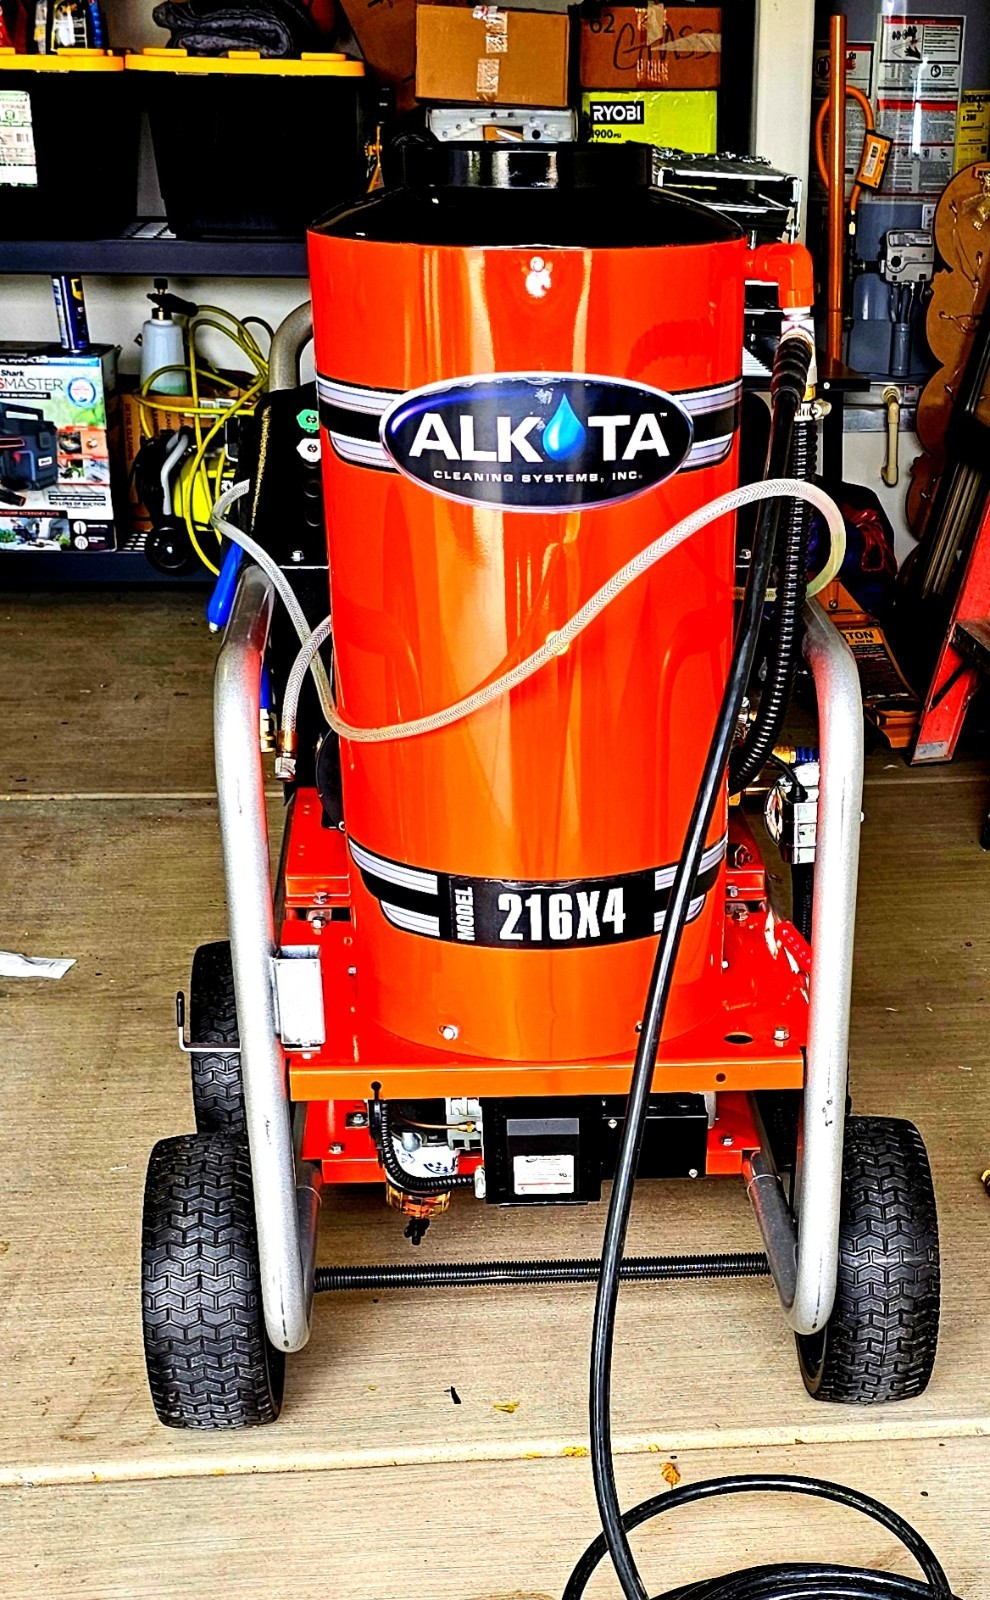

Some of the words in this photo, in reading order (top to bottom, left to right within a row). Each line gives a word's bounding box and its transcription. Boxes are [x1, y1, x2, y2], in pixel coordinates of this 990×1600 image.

[592, 105, 641, 121] RYOBI
[1, 369, 24, 377] Shark
[433, 470, 514, 483] CLEANING
[521, 473, 604, 484] SYSTEMS,
[612, 470, 643, 481] INC.
[845, 631, 874, 640] TON
[455, 886, 475, 941] MODEL
[498, 887, 626, 941] 216X4
